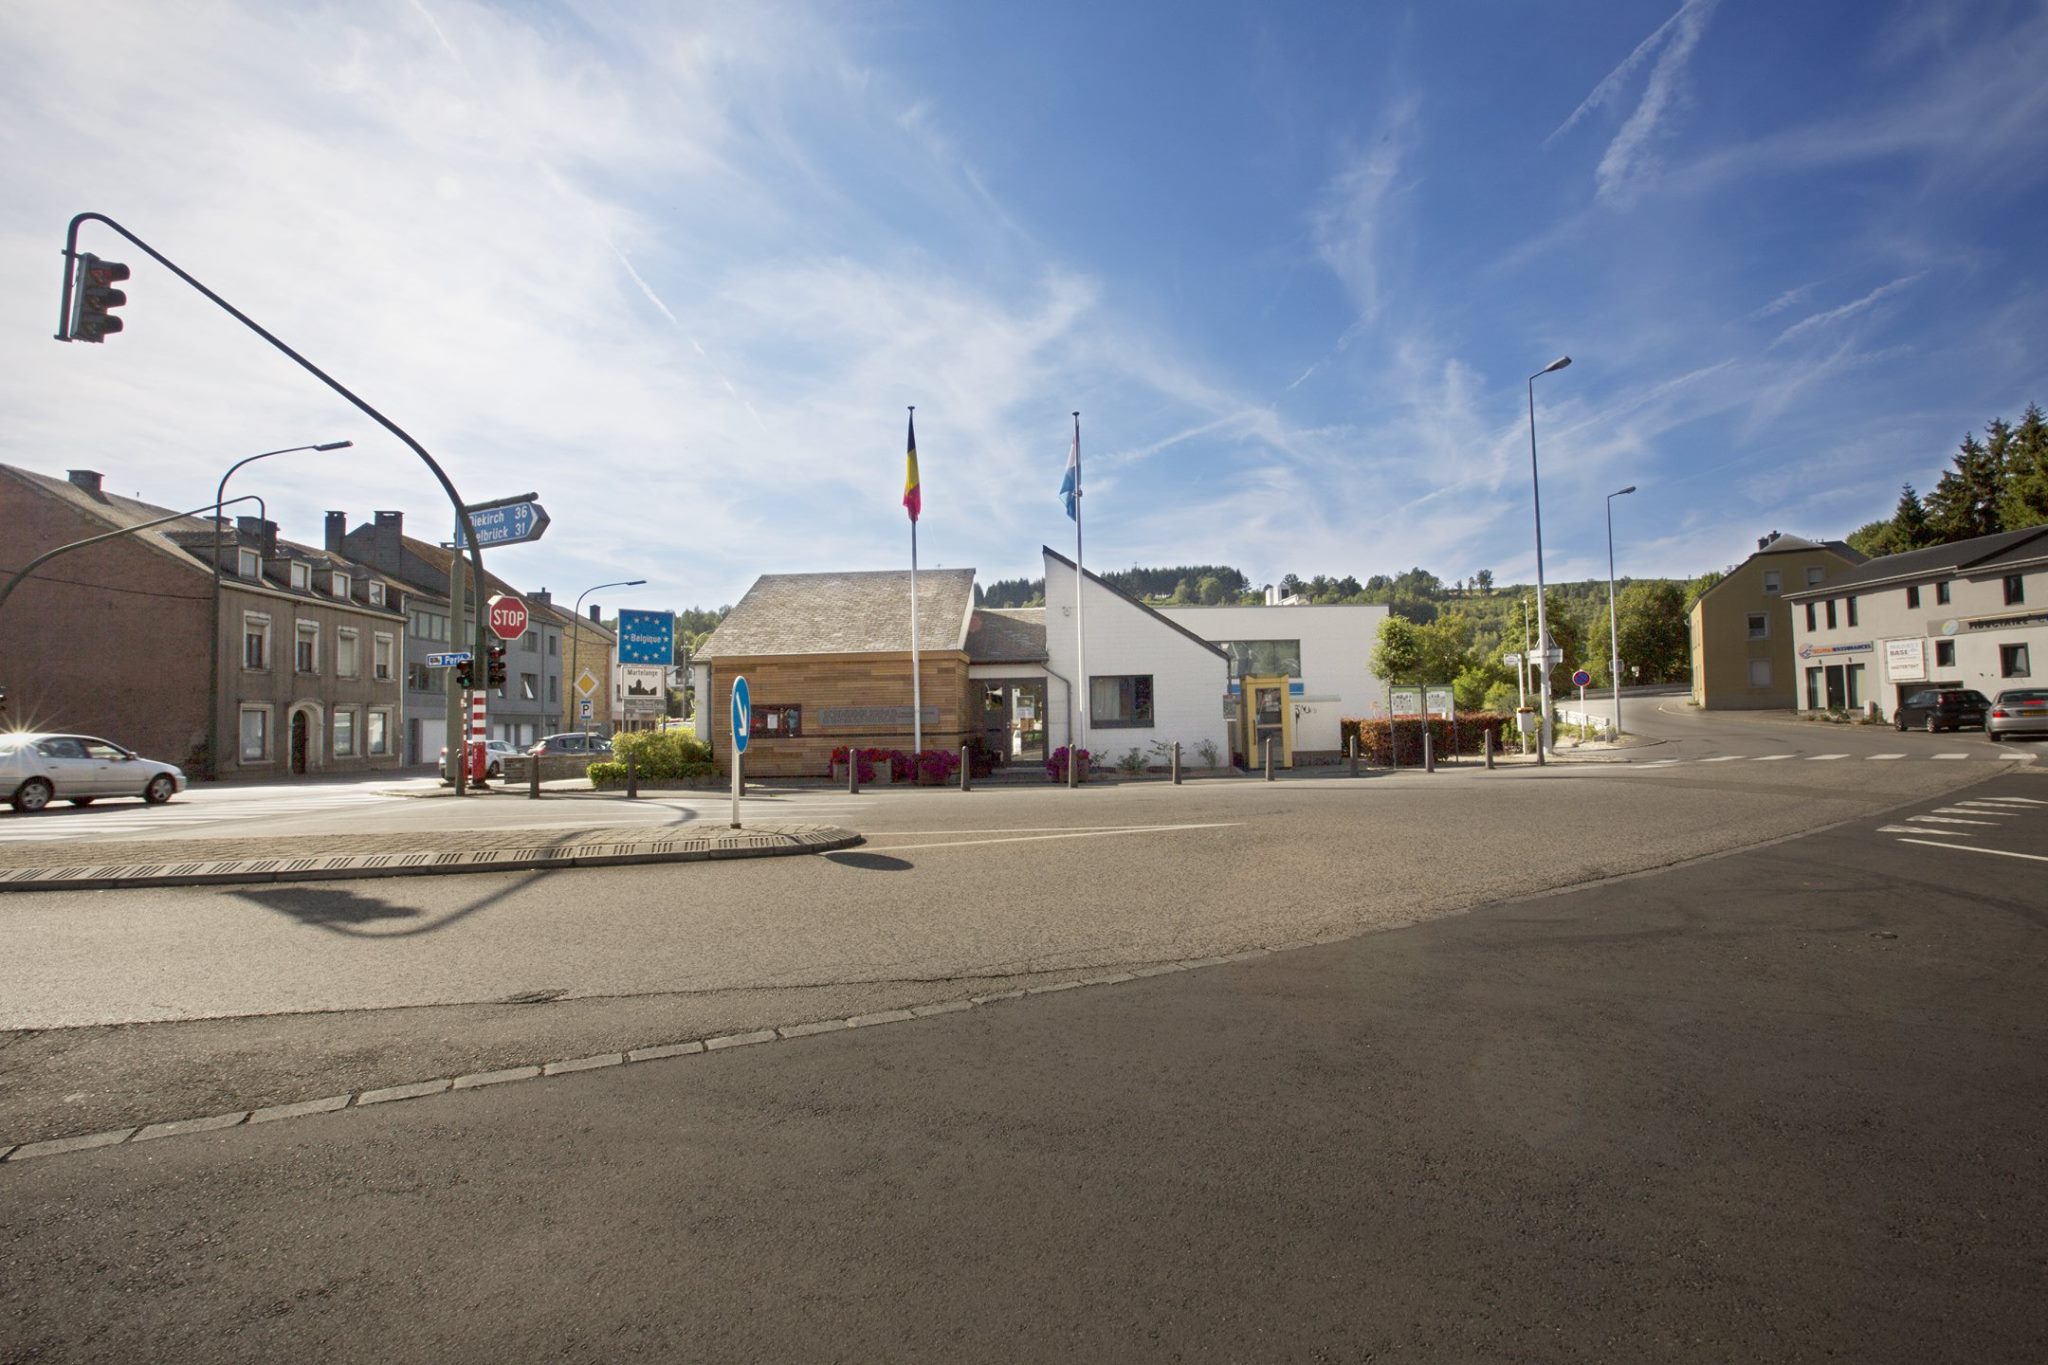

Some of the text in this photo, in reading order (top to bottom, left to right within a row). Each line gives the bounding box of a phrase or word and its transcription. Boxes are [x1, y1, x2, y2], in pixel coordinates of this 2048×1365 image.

[515, 506, 527, 519] 36
[515, 522, 525, 536] 31
[494, 609, 524, 627] STOP
[630, 633, 661, 644] Belgique
[627, 669, 658, 678] Martelange
[583, 704, 590, 715] P
